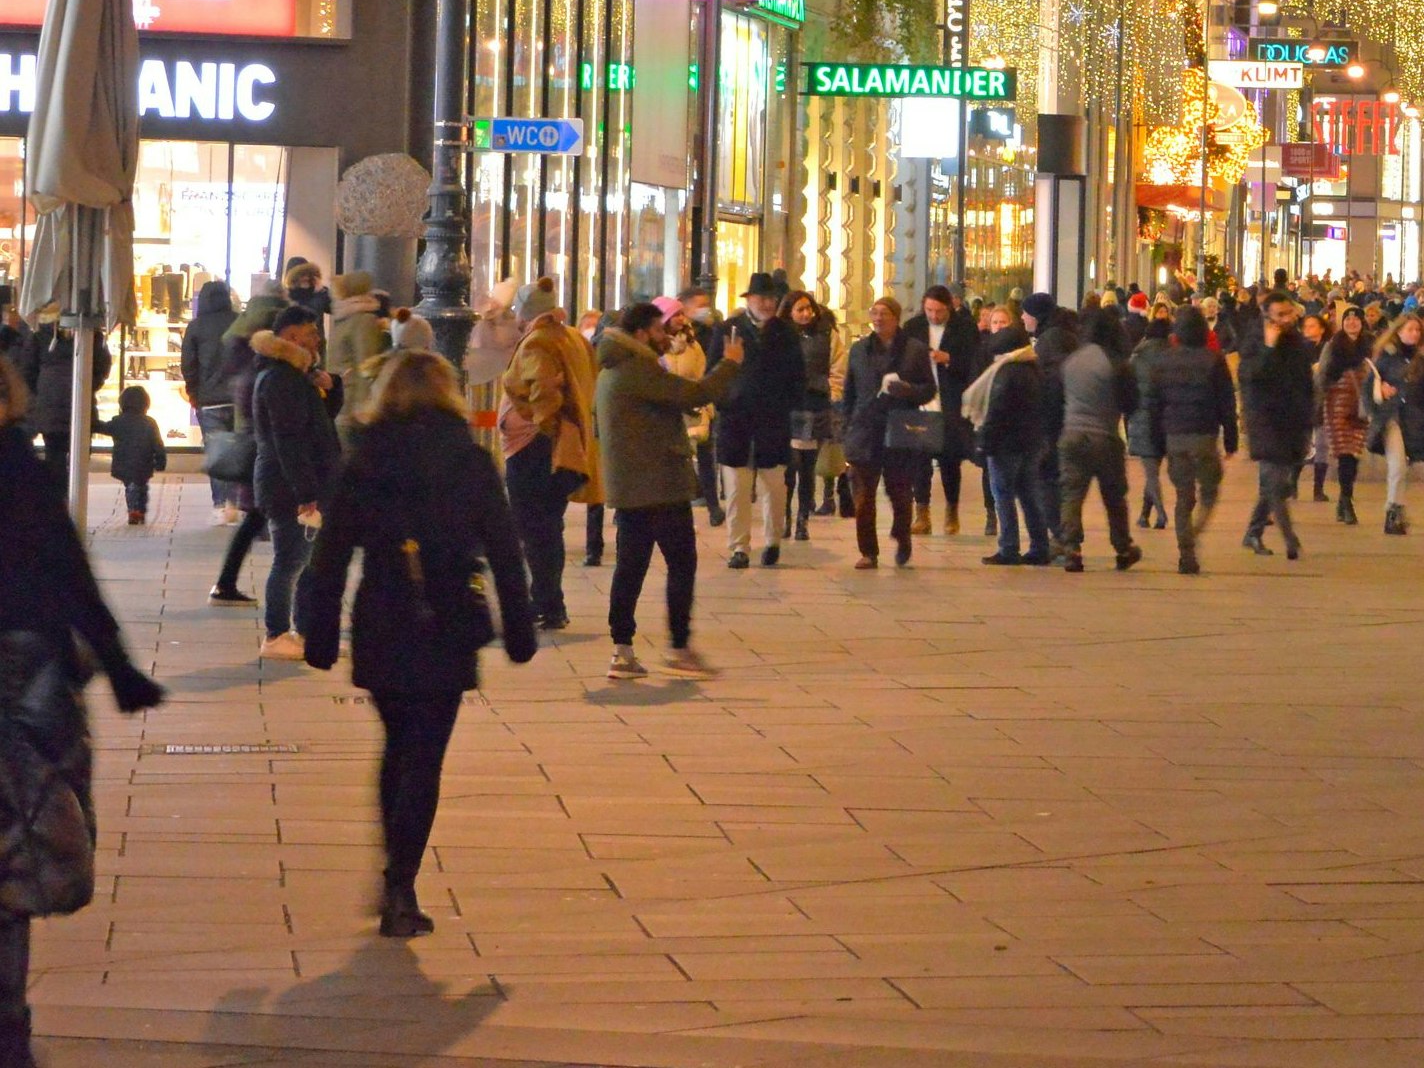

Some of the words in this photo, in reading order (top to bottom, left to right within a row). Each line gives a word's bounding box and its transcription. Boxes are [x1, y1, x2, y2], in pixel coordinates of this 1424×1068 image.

[816, 66, 1006, 97] SALAMANDER
[1241, 67, 1302, 83] KLIMT
[507, 125, 539, 146] WC
